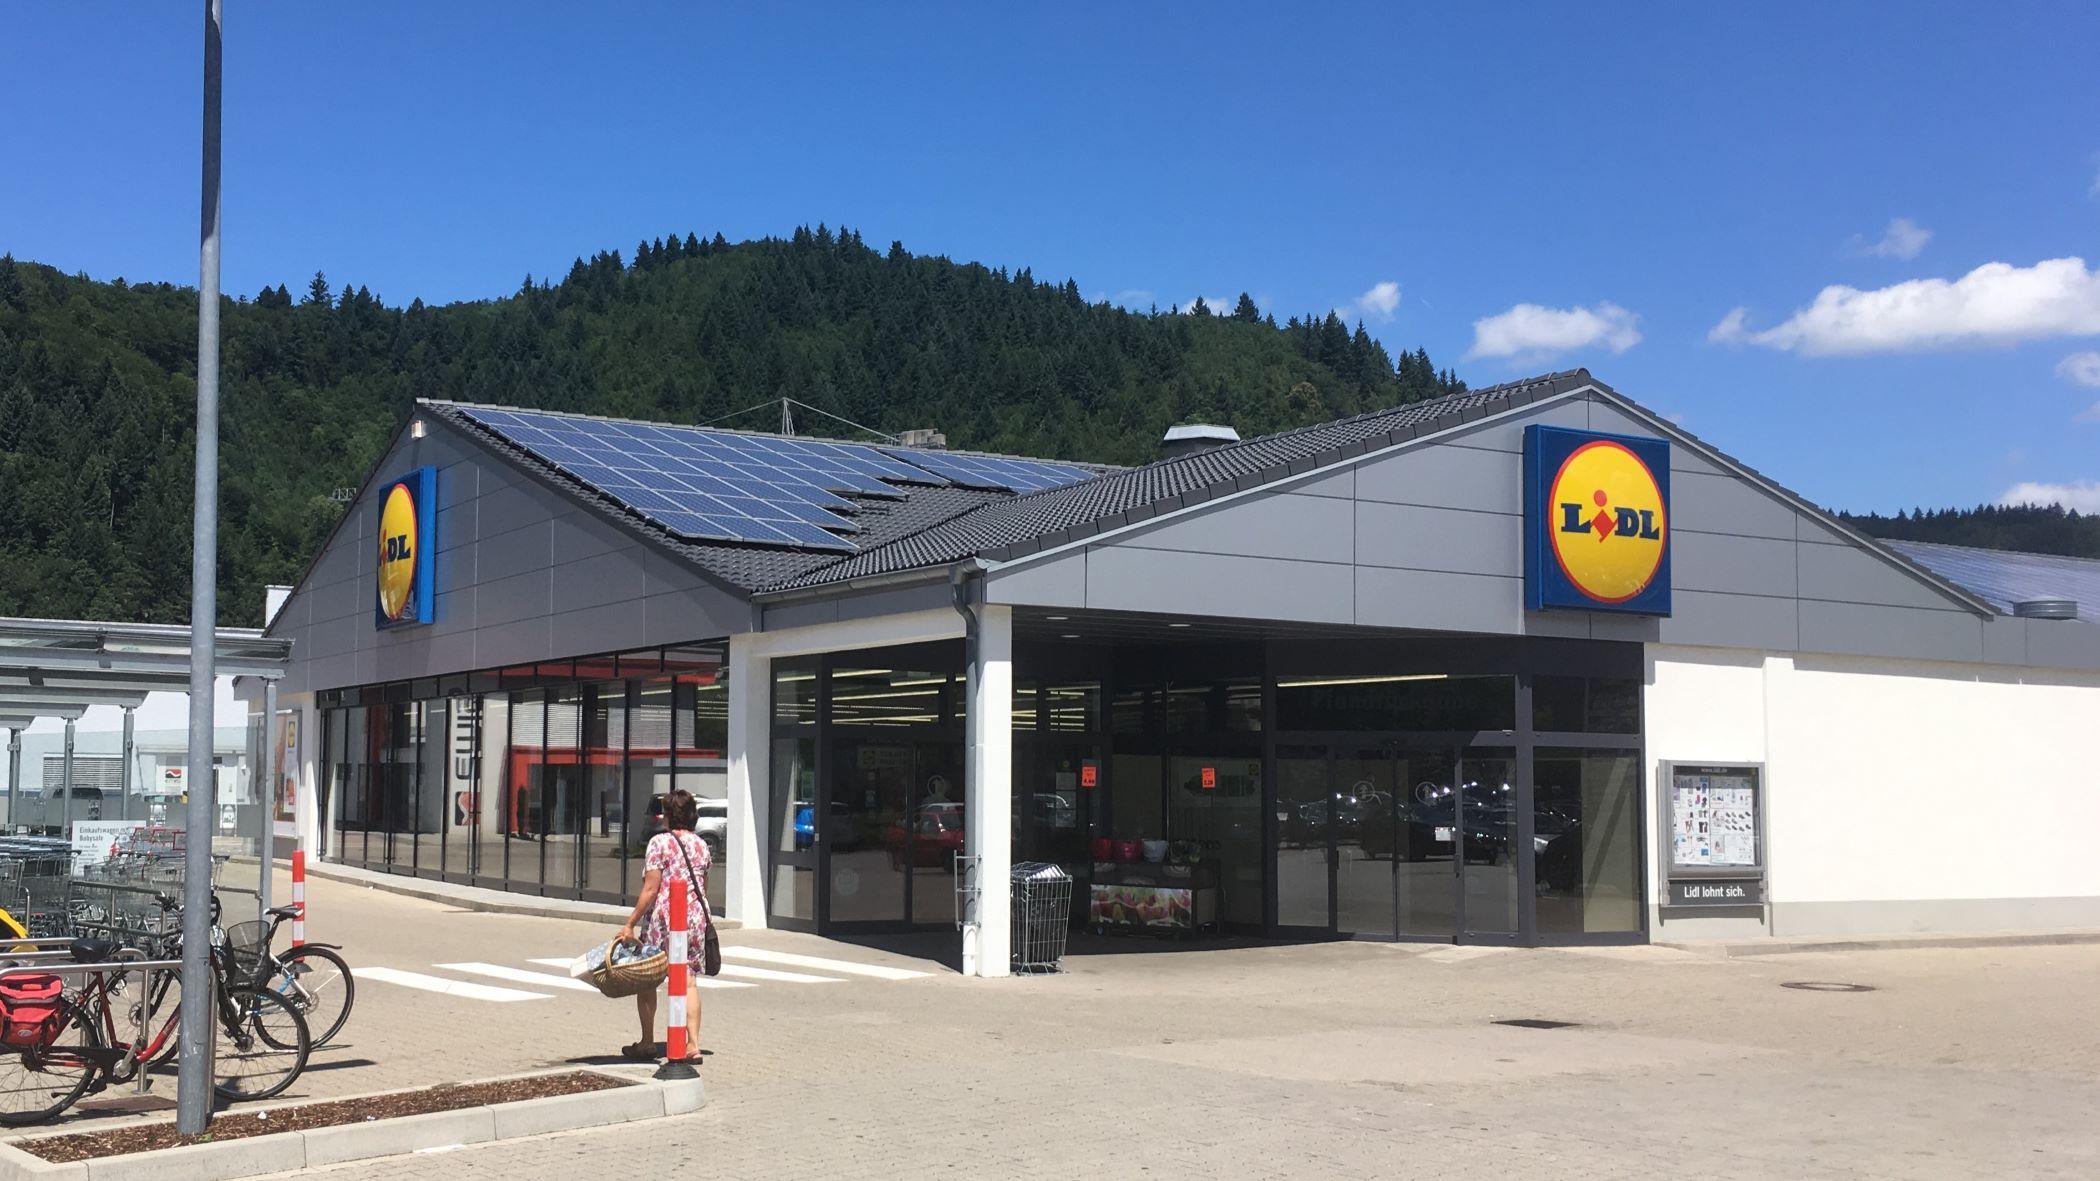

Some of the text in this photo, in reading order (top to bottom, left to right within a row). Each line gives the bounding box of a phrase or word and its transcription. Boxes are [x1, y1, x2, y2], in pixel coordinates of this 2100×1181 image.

[1560, 489, 1660, 544] LIDL
[1684, 884, 1746, 898] Lidl lohnt sich.
